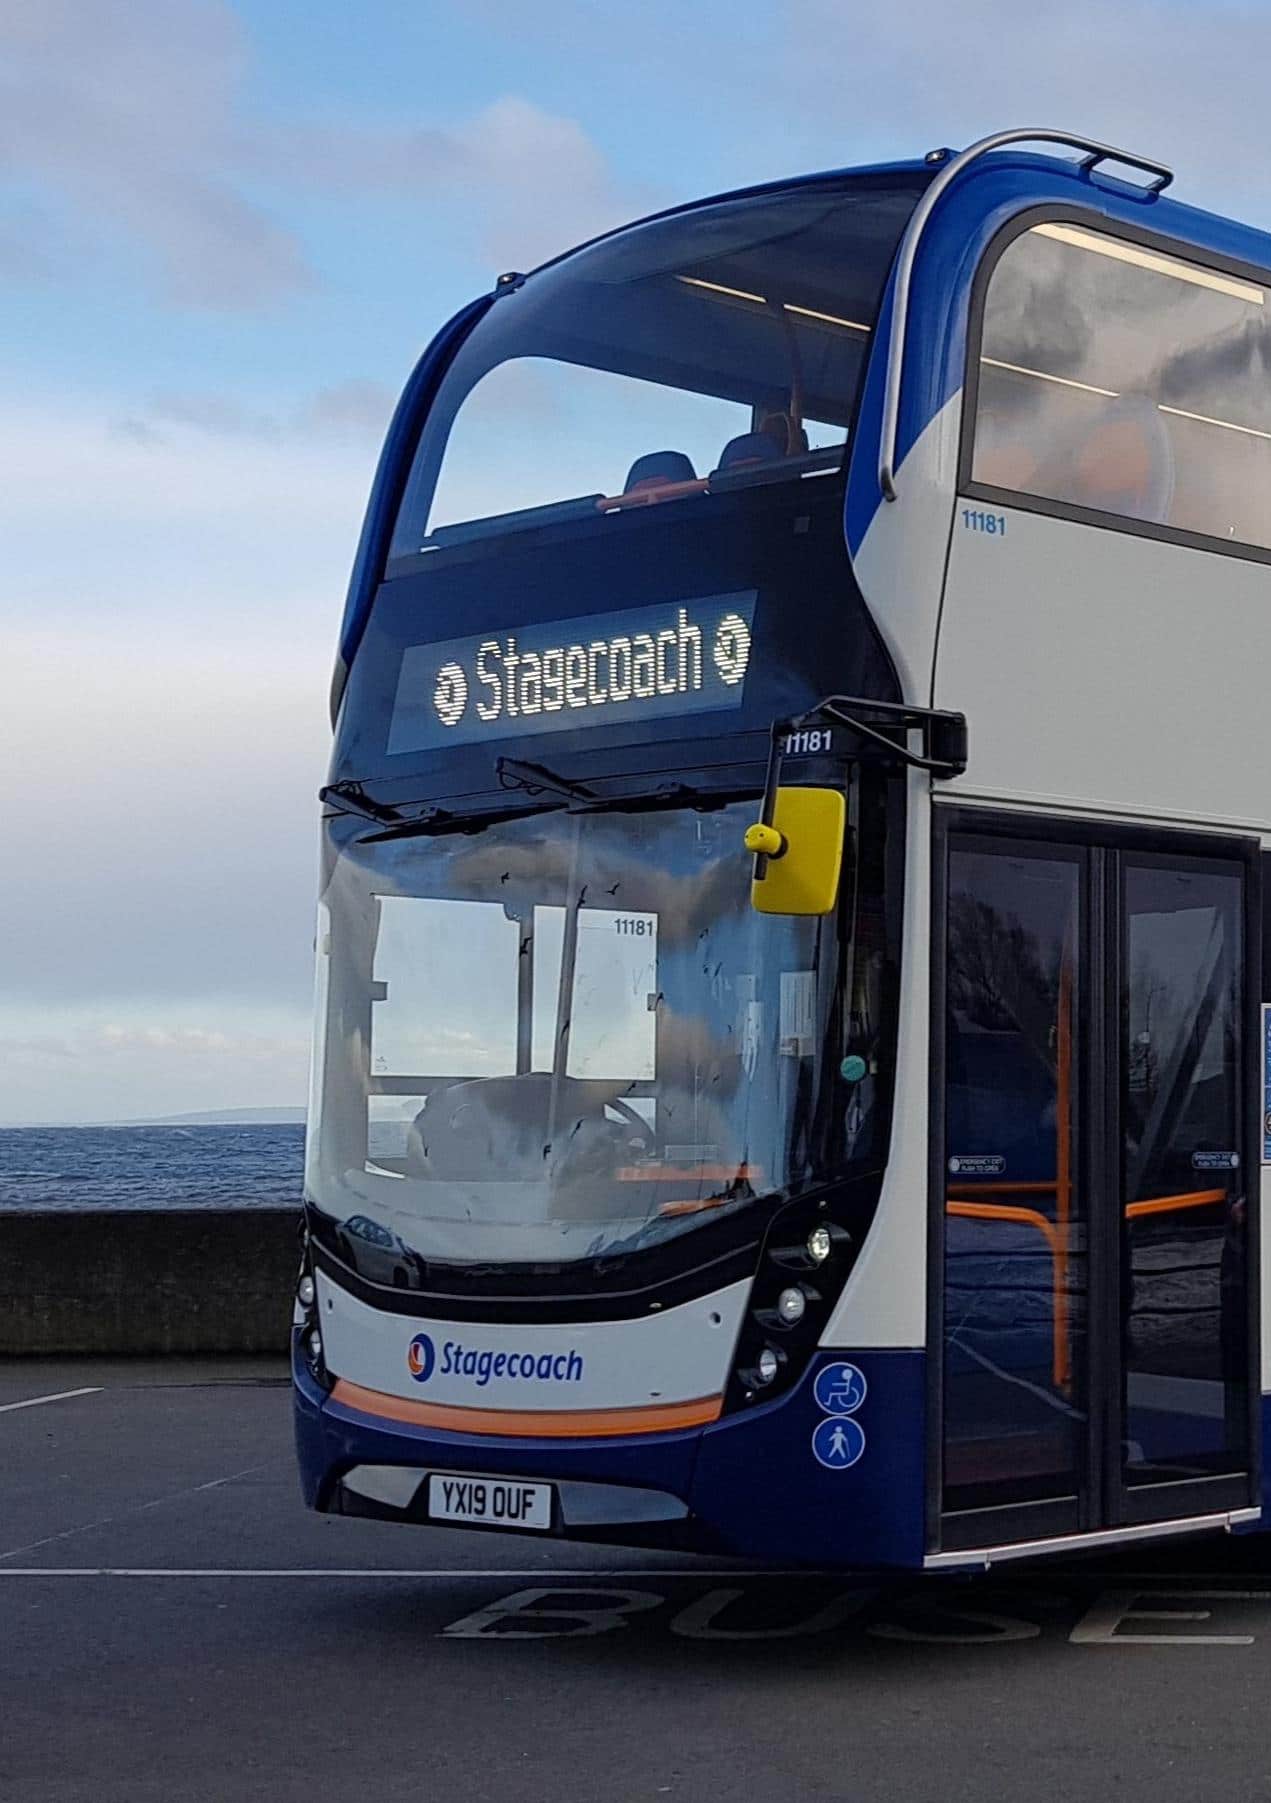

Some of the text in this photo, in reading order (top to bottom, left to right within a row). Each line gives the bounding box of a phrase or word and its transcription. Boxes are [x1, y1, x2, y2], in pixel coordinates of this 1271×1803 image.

[962, 509, 1005, 536] 11181
[476, 608, 702, 721] Stagecoach
[785, 729, 832, 754] 11181
[614, 918, 653, 937] 11181
[440, 1341, 583, 1387] Stagecoach
[442, 1481, 536, 1520] YX19 OUF
